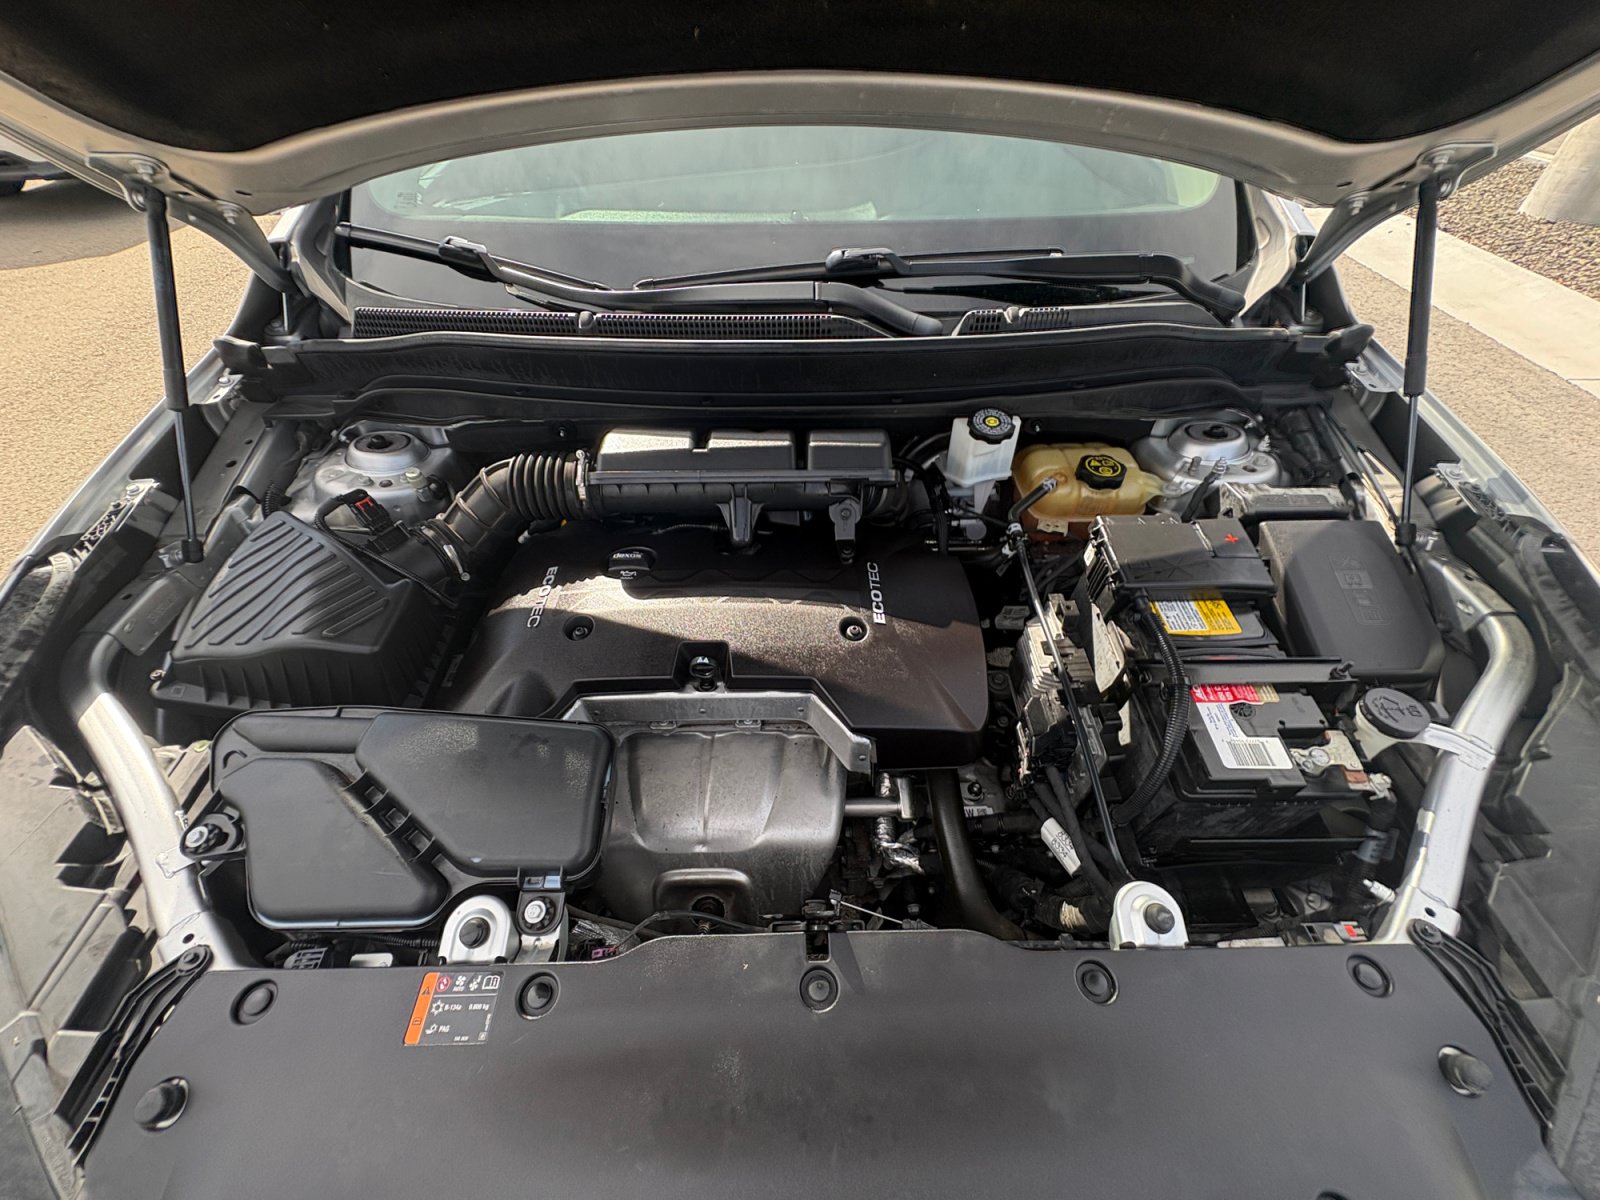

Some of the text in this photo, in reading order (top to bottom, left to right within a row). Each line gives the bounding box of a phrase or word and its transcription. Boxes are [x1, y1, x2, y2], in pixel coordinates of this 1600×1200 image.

[527, 566, 559, 628] ECOTEC
[867, 561, 886, 625] ECOTEC
[438, 1025, 450, 1033] PAG
